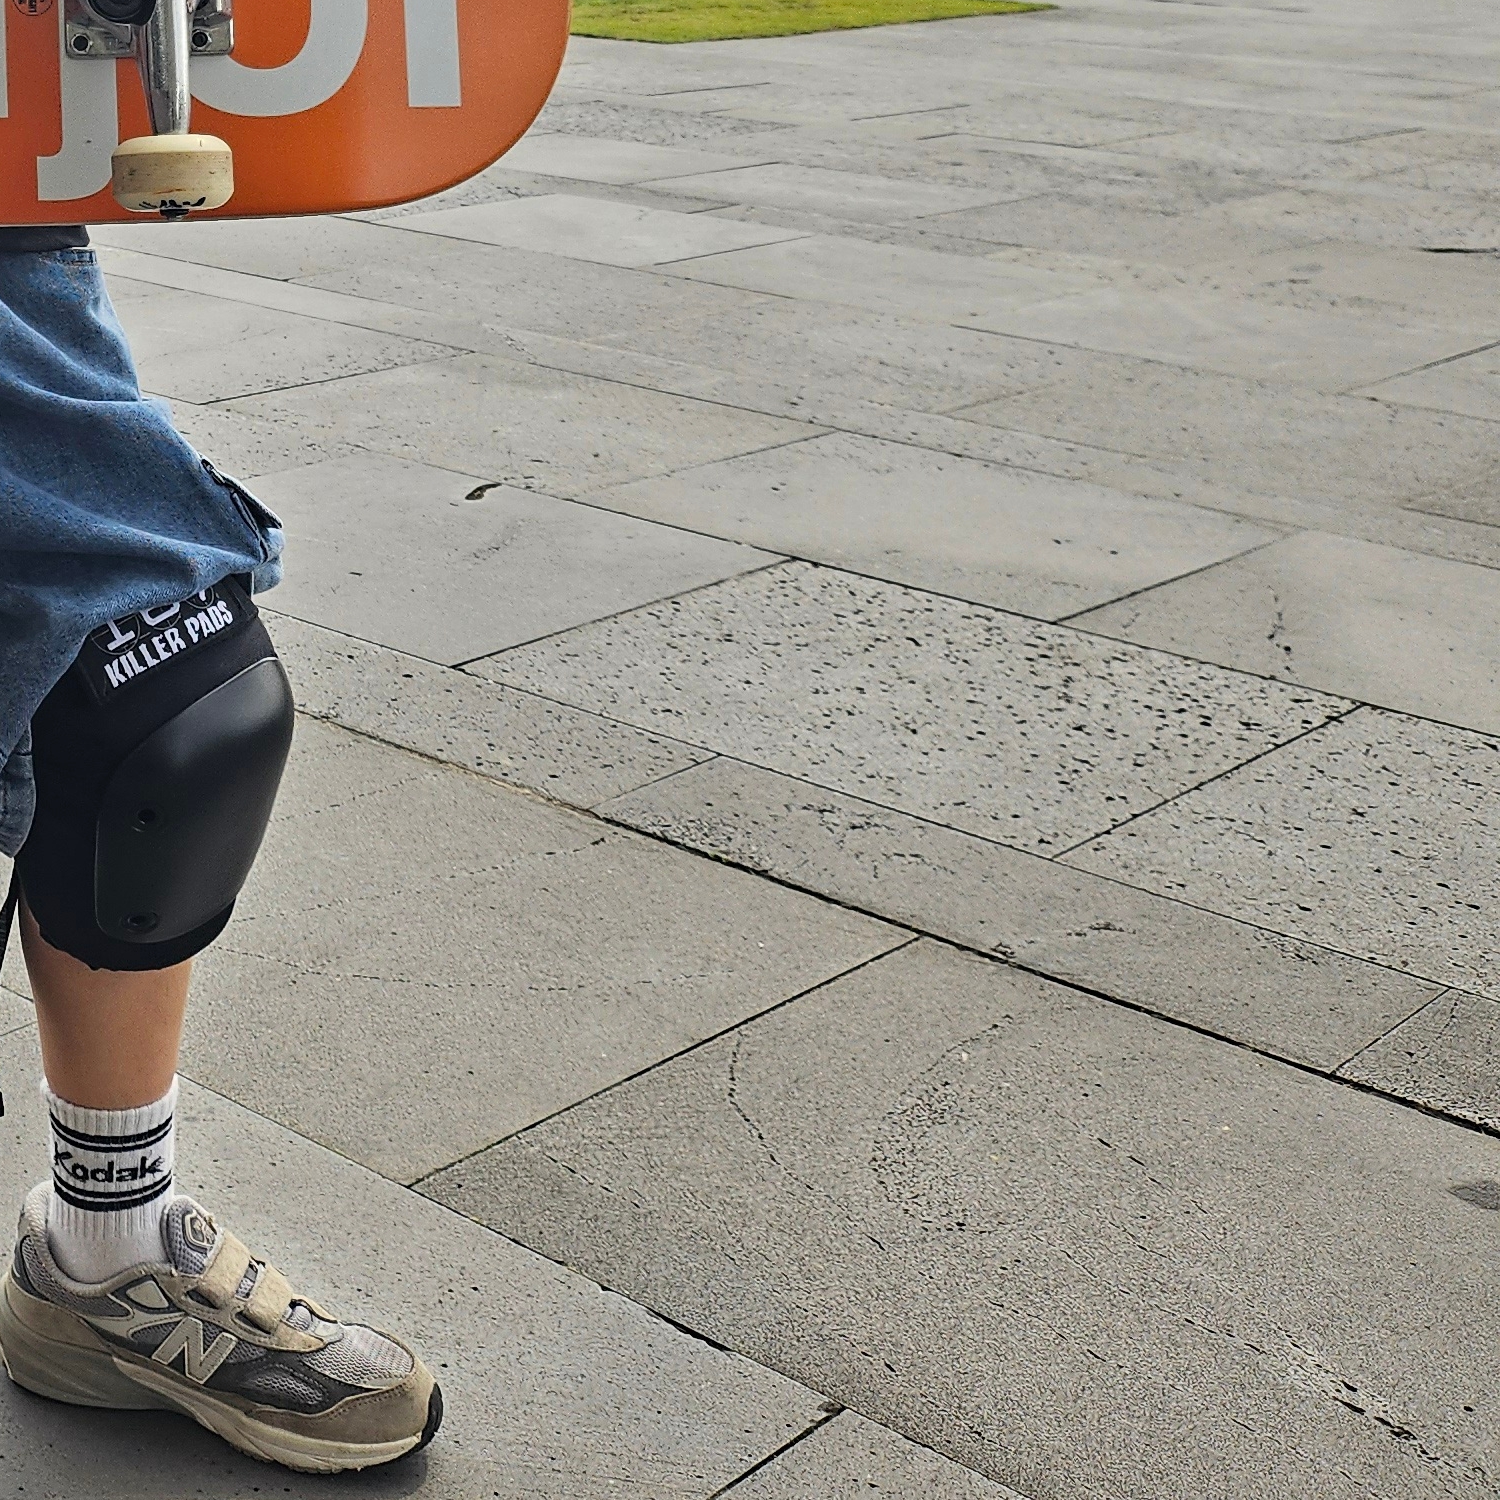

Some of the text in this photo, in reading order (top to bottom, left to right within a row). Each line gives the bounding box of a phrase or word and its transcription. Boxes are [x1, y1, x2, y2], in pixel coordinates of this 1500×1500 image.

[103, 627, 187, 688] KILLER
[184, 600, 233, 644] PADS
[54, 1141, 165, 1183] Kodak
[151, 1317, 239, 1385] N
